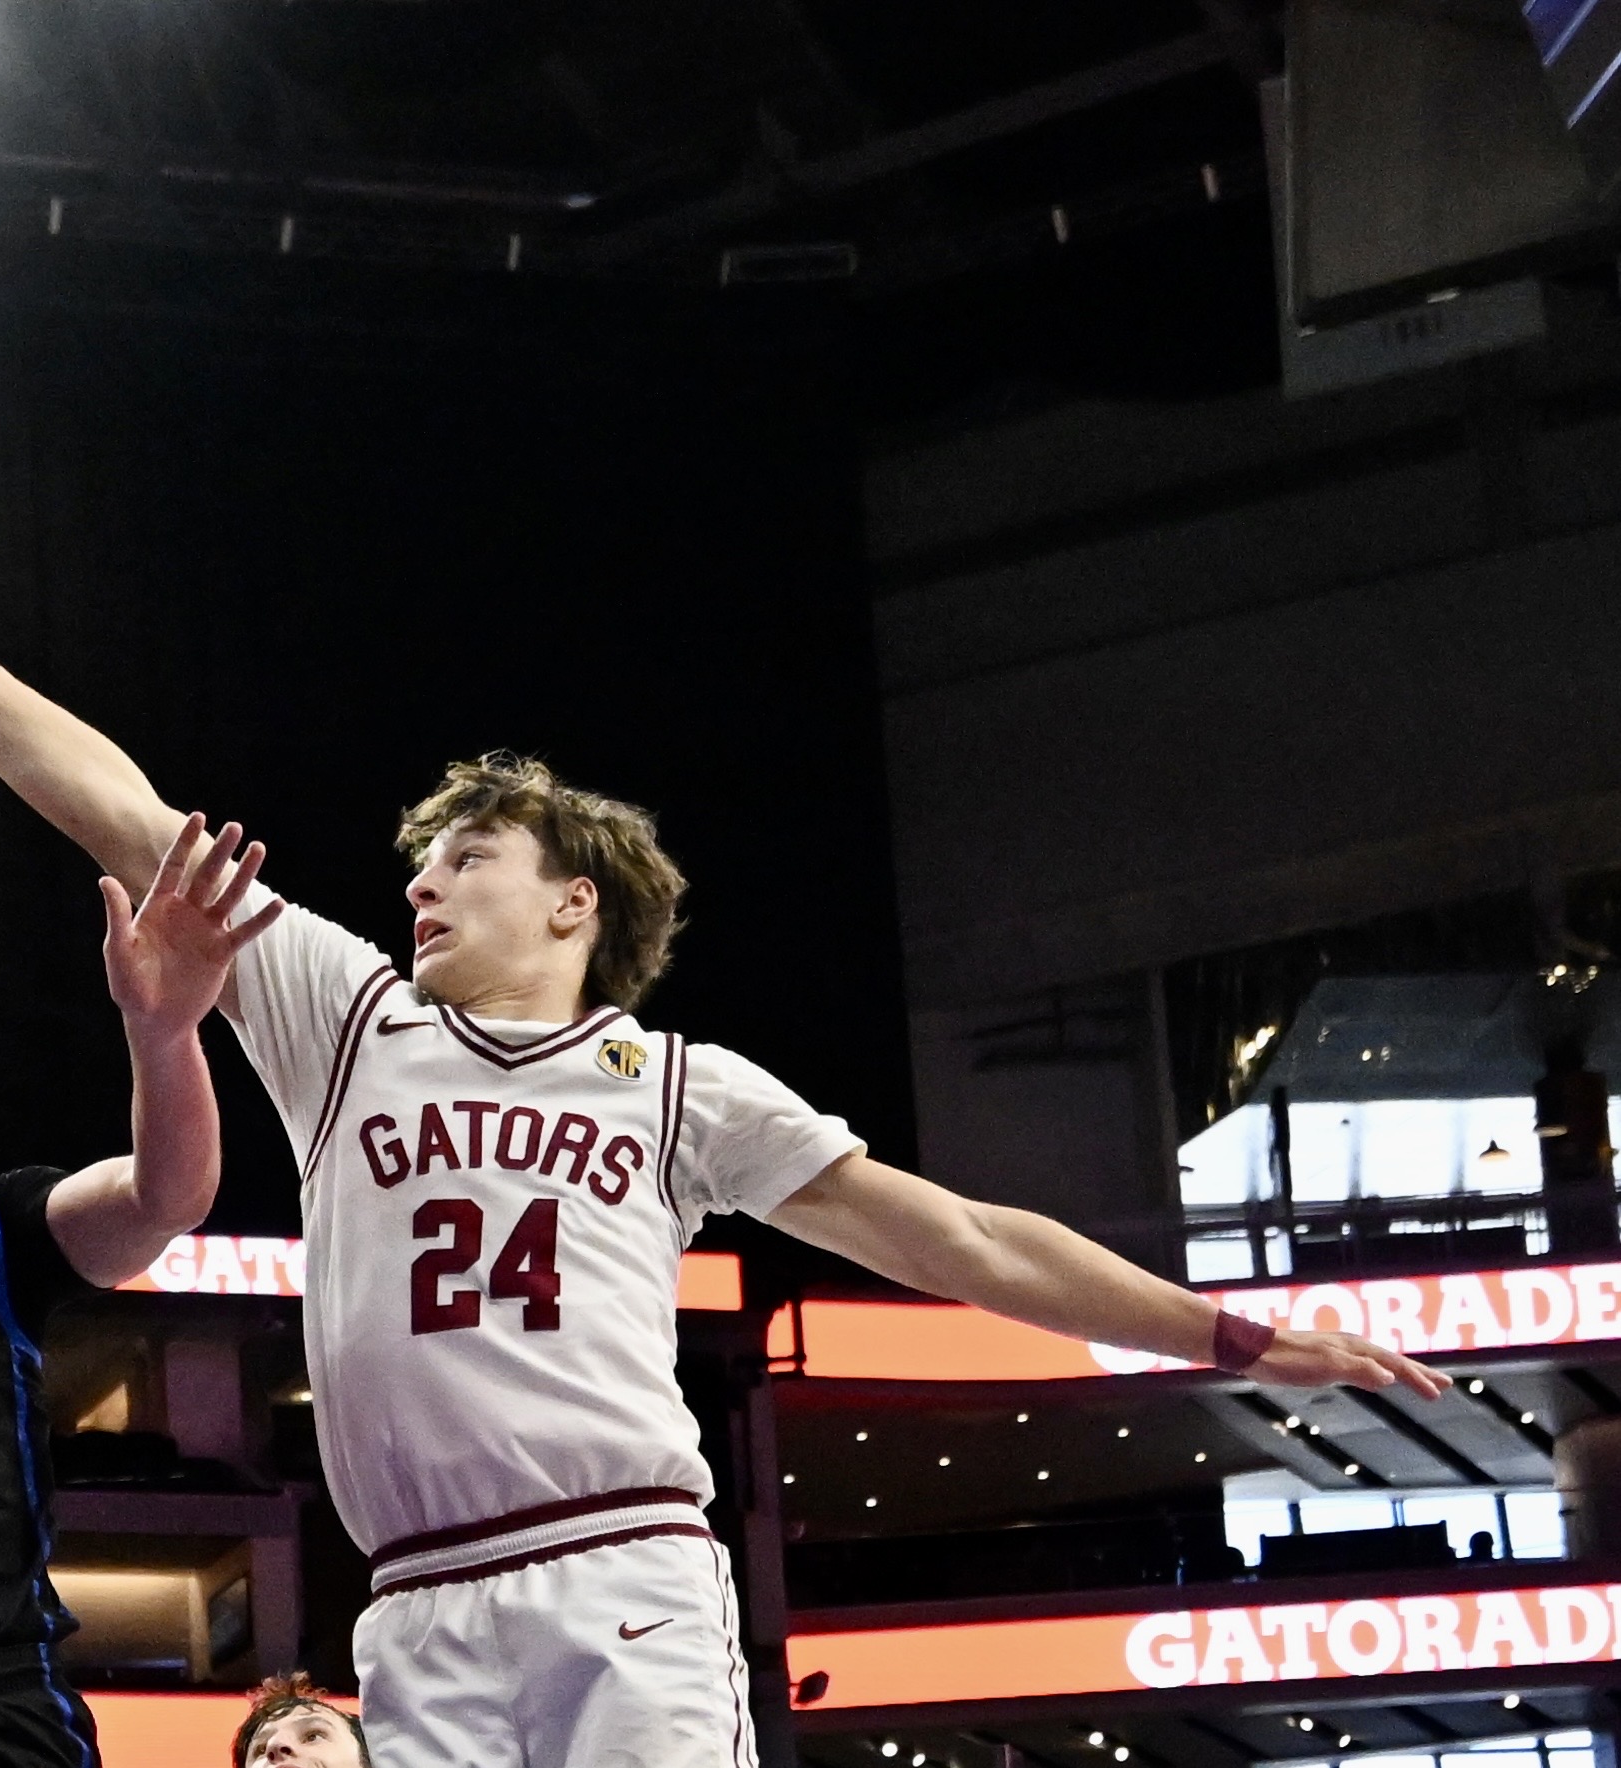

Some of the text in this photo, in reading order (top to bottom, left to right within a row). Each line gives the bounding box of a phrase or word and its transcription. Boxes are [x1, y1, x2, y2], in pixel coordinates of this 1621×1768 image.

[359, 1101, 645, 1206] GATORS
[411, 1198, 562, 1336] 24
[1125, 1583, 1621, 1689] GATORAD
